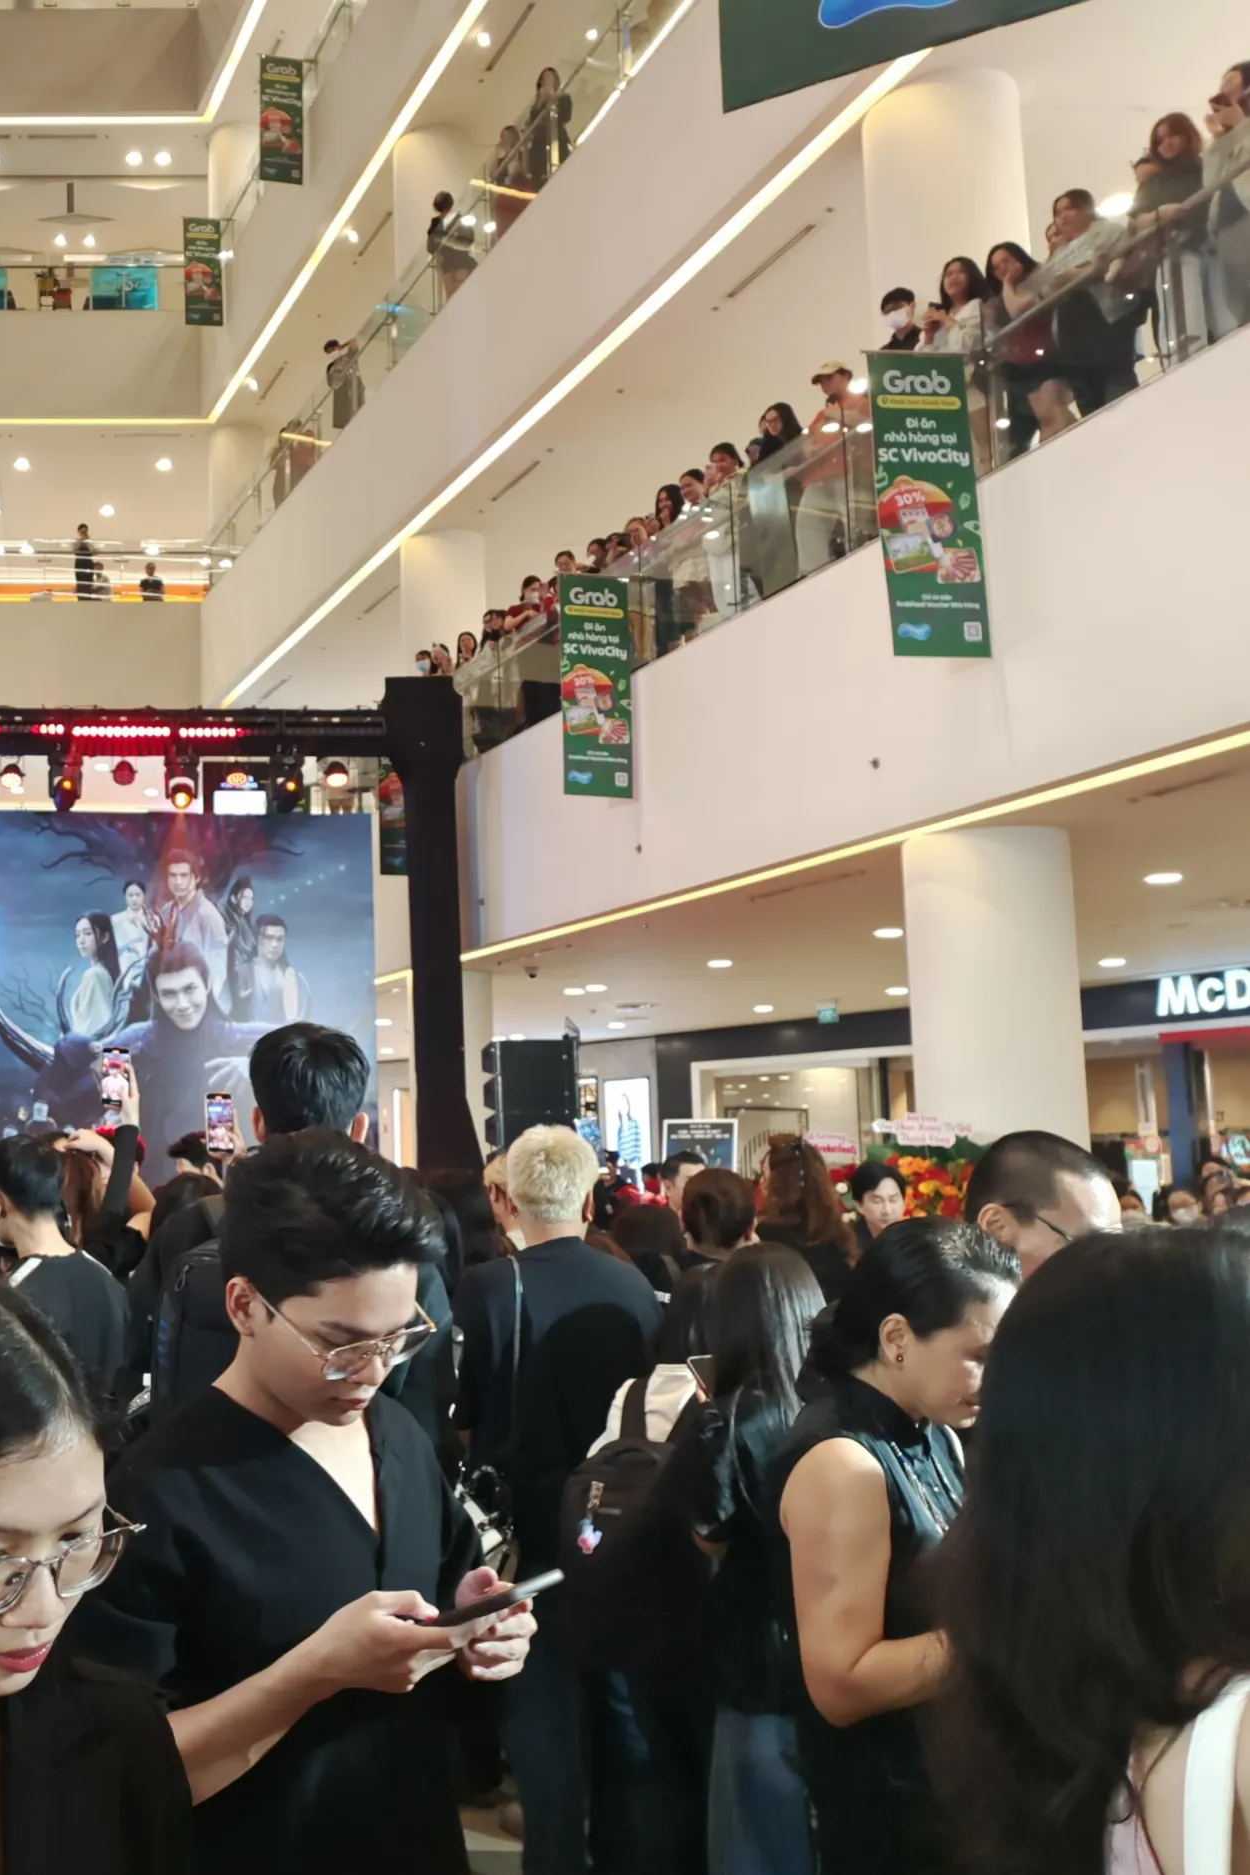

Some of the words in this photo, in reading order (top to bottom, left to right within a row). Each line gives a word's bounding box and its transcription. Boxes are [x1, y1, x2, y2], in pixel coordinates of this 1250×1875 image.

[882, 369, 951, 394] Grab
[905, 417, 918, 429] Đi
[883, 430, 907, 443] nhà
[908, 431, 939, 446] hàng
[941, 431, 957, 445] tại
[878, 447, 899, 463] SC
[900, 447, 970, 467] VivoCity
[894, 490, 925, 507] 30%
[569, 586, 618, 607] Grab
[563, 643, 578, 654] SC
[579, 643, 627, 661] VivoCity
